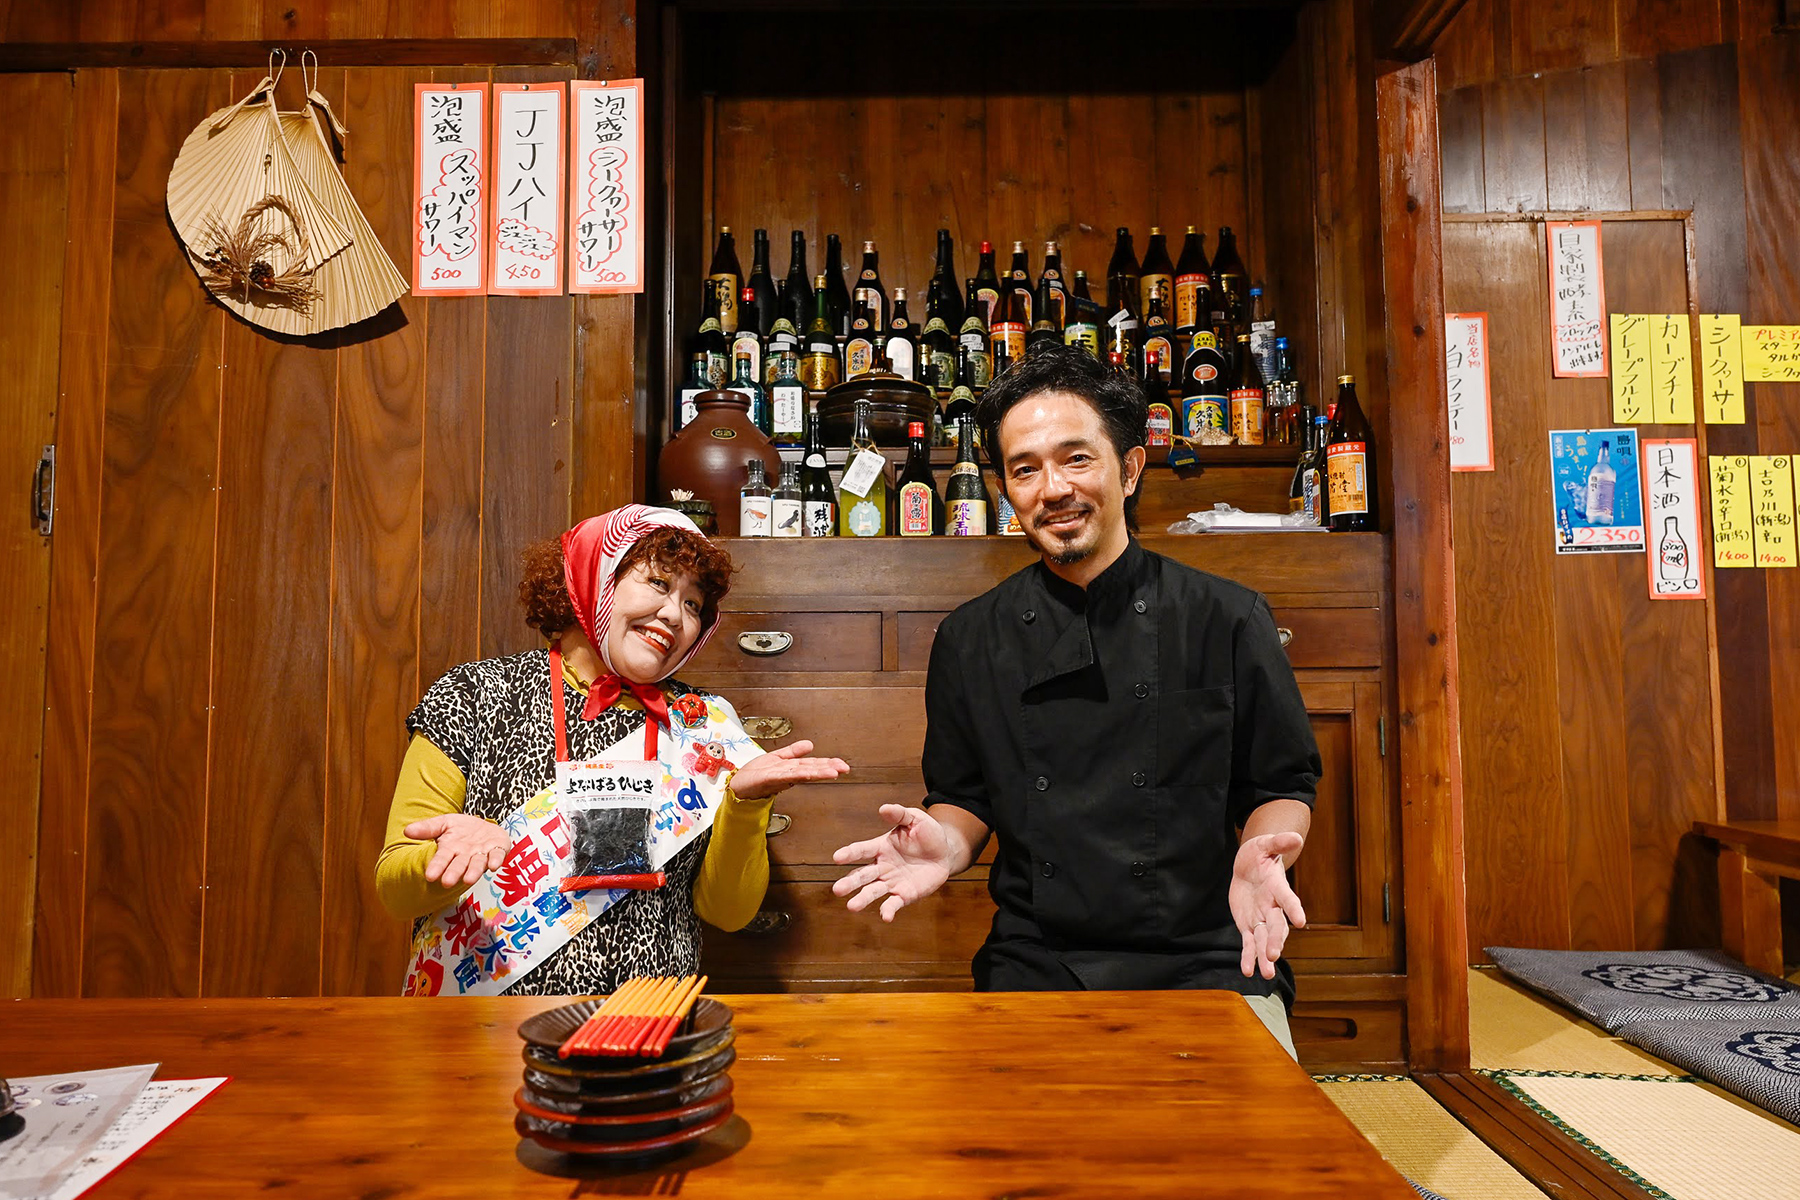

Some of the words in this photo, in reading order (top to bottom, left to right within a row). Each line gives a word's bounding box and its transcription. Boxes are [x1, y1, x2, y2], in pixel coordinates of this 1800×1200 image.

[430, 96, 463, 144] 泡盛
[594, 96, 627, 144] 泡盛
[424, 202, 442, 247] サワー
[447, 154, 476, 255] スッパイマン
[578, 222, 598, 269] サワー
[430, 268, 462, 281] 500
[505, 263, 541, 280] 450
[594, 268, 626, 282] 500
[1752, 329, 1800, 340] プレミア
[1620, 317, 1645, 422] グレープフルーツ
[1662, 322, 1684, 415] カーブチー
[1653, 448, 1681, 510] 日本酒
[1714, 466, 1735, 530] 菊水の辛口
[1759, 470, 1777, 511] 吉乃川
[1662, 542, 1684, 552] 300
[1657, 582, 1681, 594] ビン
